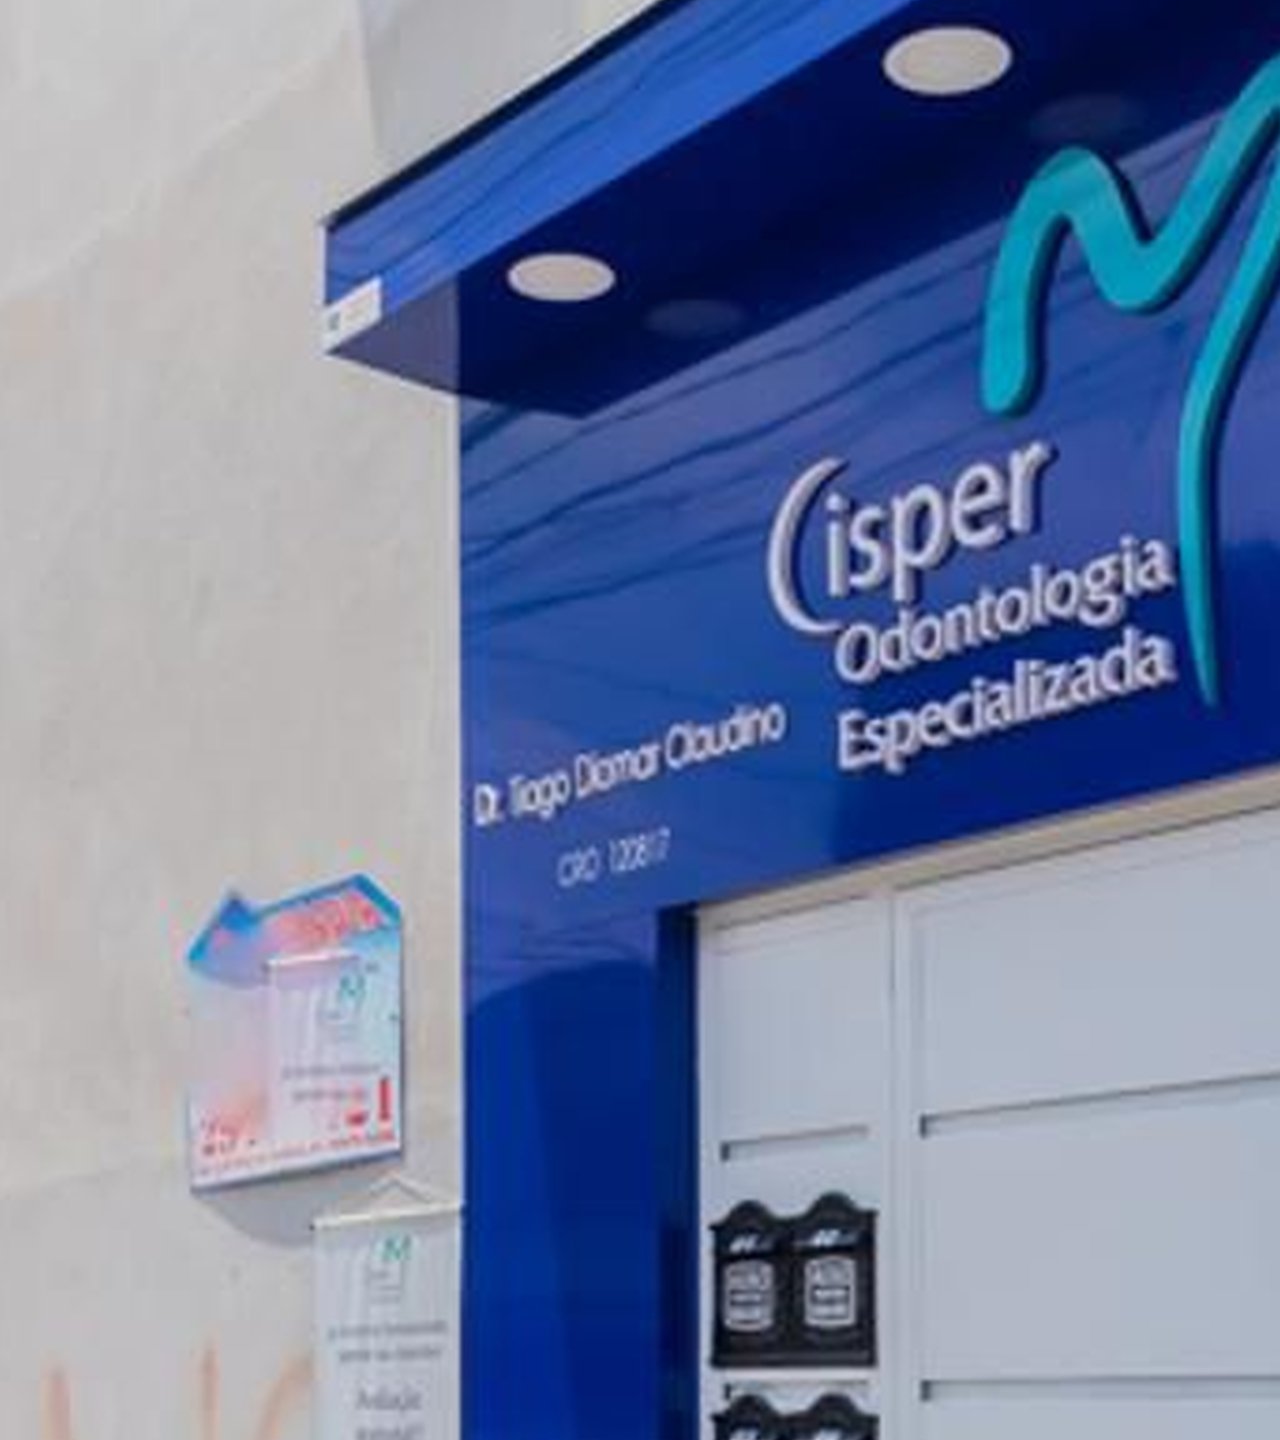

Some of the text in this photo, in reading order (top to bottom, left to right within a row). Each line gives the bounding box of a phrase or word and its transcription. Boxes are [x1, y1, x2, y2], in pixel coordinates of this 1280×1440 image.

[767, 440, 1052, 635] Cisper
[834, 534, 1176, 684] Odontologia
[664, 702, 786, 770] Claudino
[836, 626, 1178, 774] Especializada
